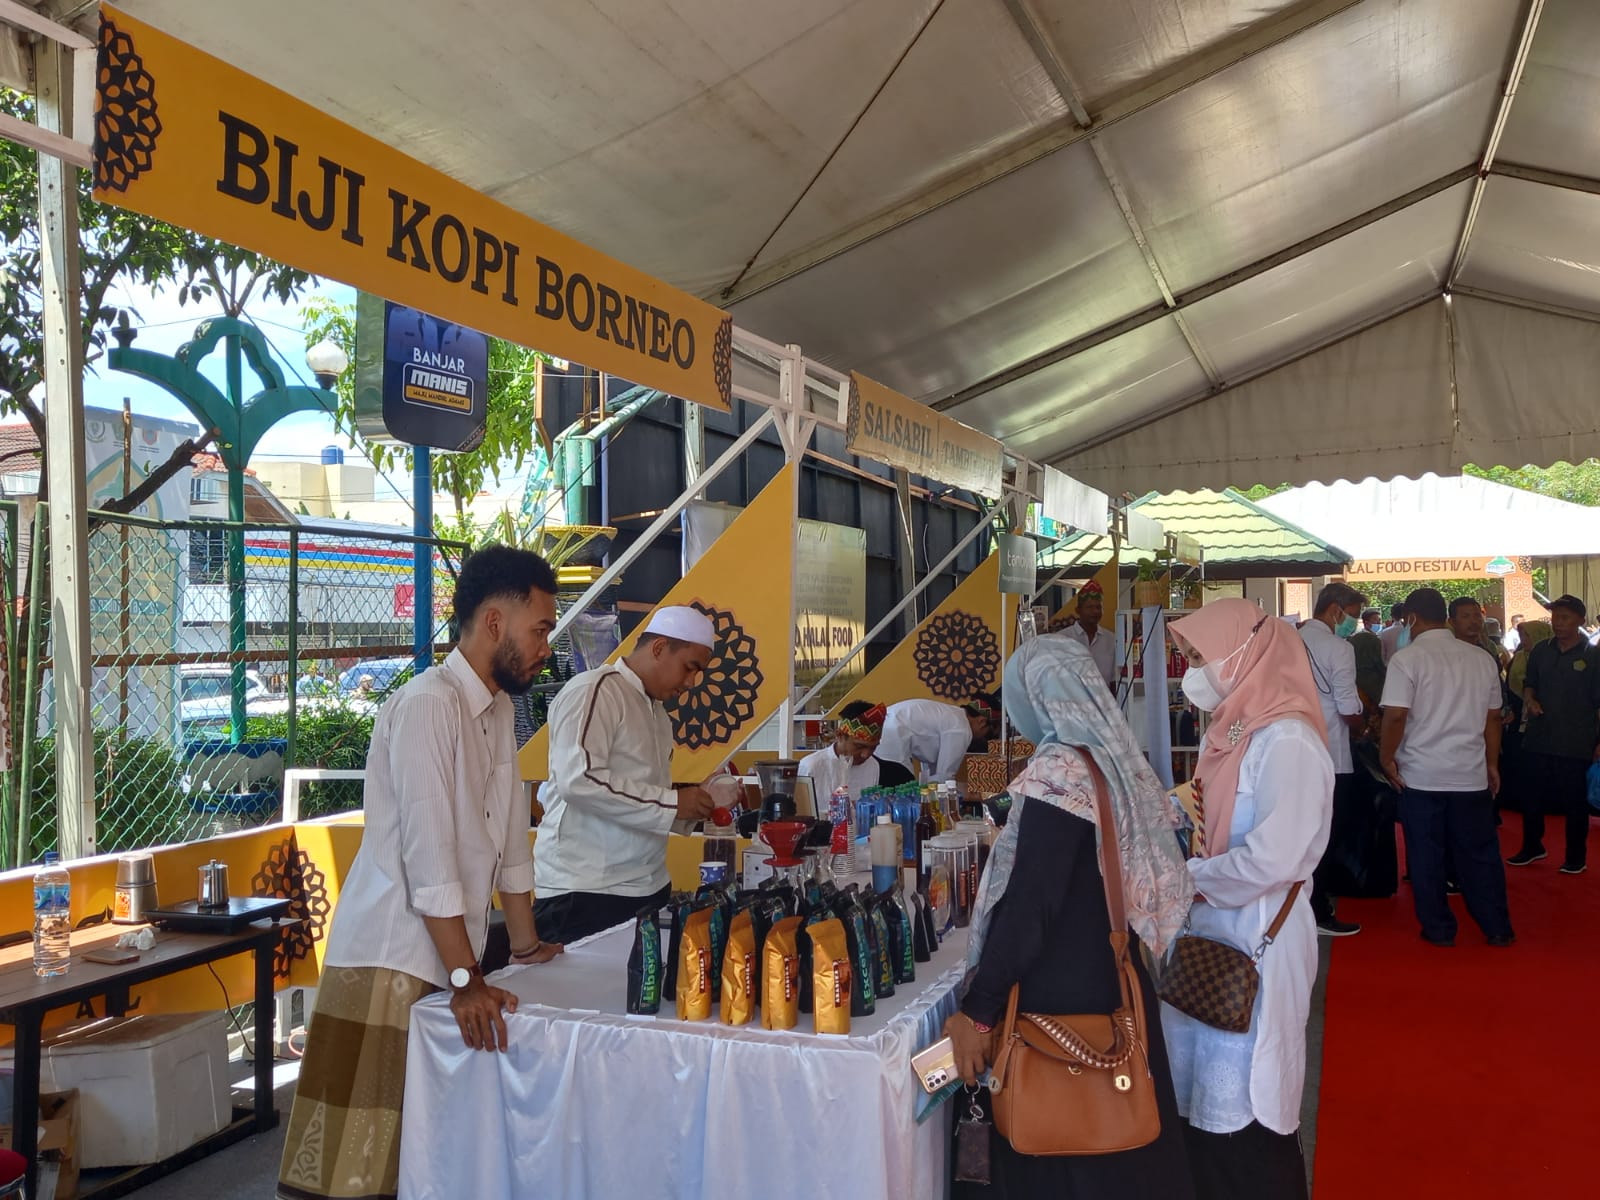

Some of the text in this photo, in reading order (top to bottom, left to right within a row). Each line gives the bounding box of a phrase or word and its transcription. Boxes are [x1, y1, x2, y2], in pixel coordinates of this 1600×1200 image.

[217, 110, 695, 369] BIJI KOPI BORNEO
[413, 347, 465, 374] BANJAR
[410, 369, 468, 396] MANIS
[864, 401, 933, 459] SALSABIL
[1376, 561, 1412, 573] FOOD
[1415, 559, 1481, 572] FESTIVAL
[803, 625, 830, 648] HALAL
[832, 626, 853, 648] FOOD
